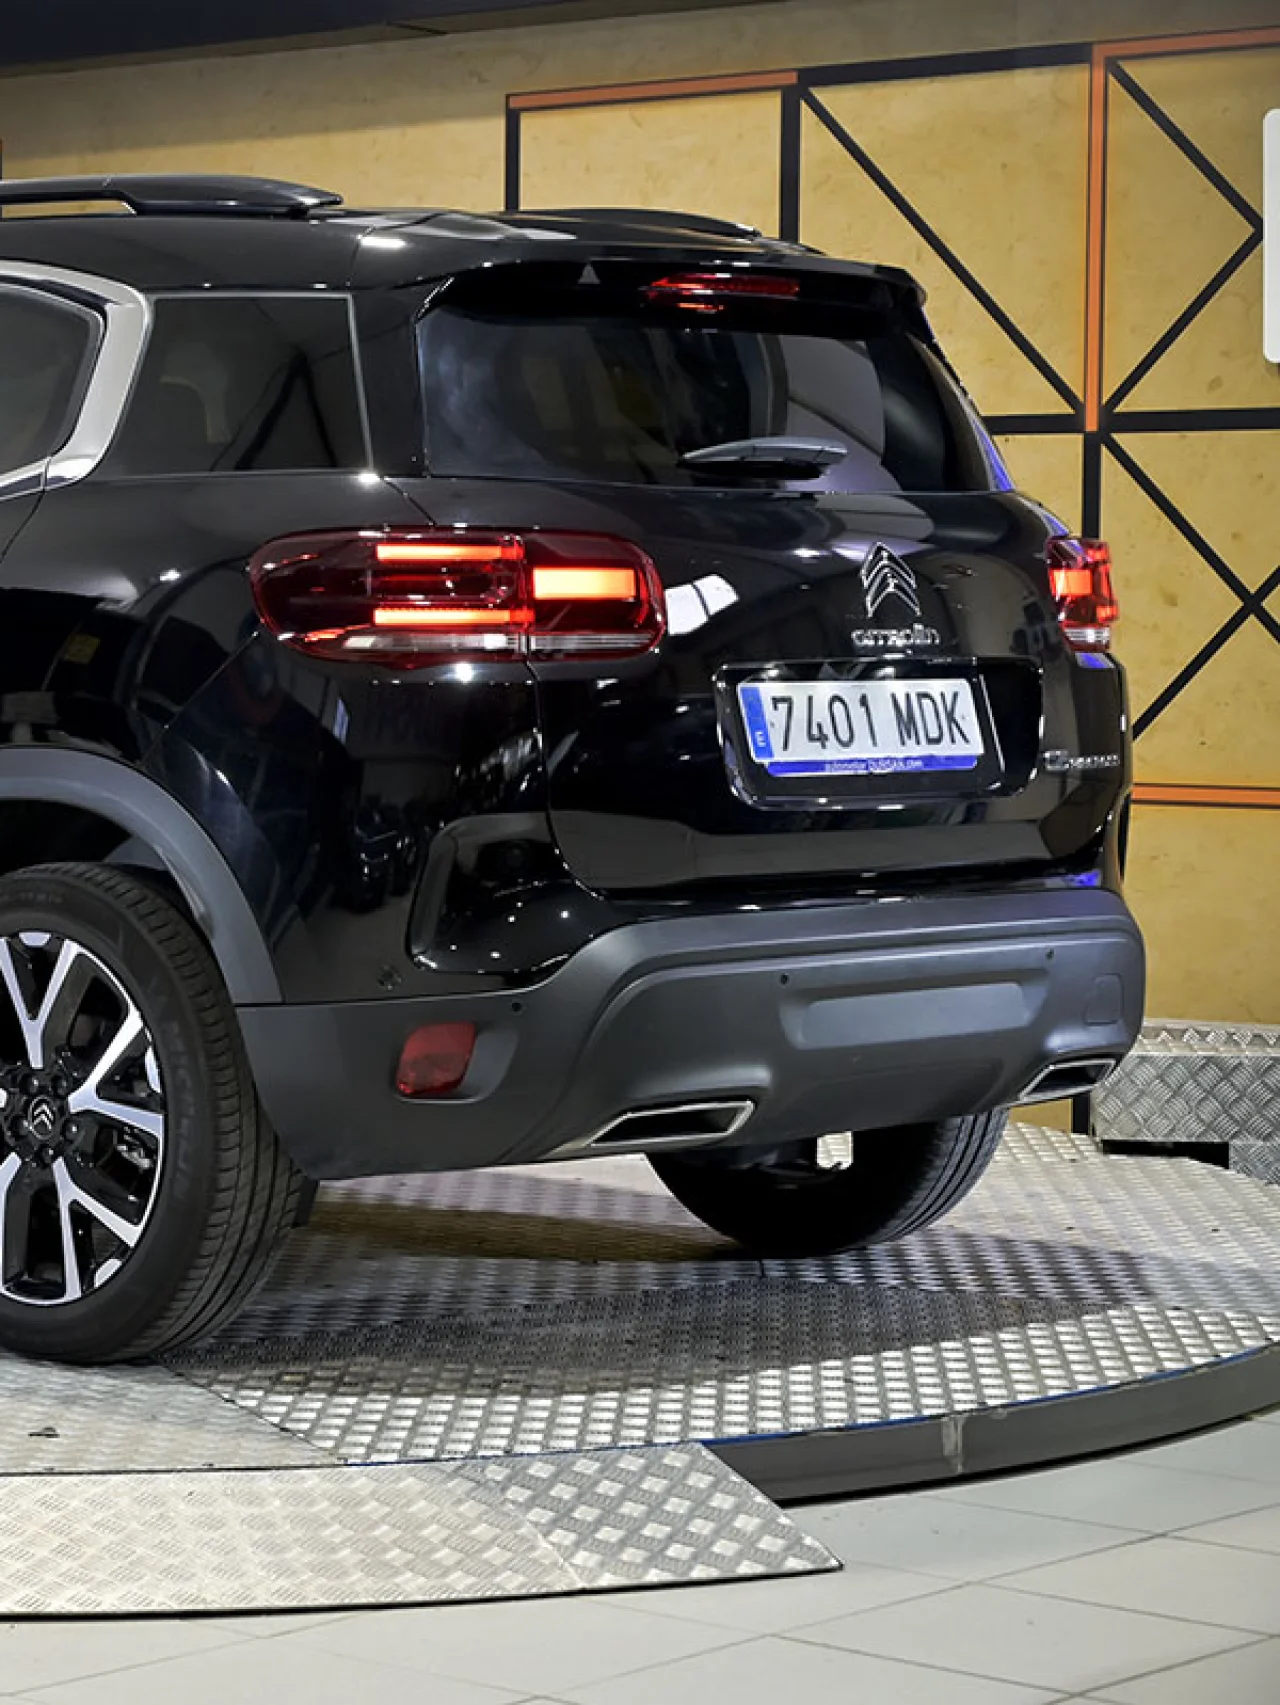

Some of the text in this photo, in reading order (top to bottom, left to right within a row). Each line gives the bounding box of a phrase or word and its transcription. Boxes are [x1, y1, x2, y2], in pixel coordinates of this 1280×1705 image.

[754, 731, 768, 748] E
[770, 690, 971, 752] 7401 MDK
